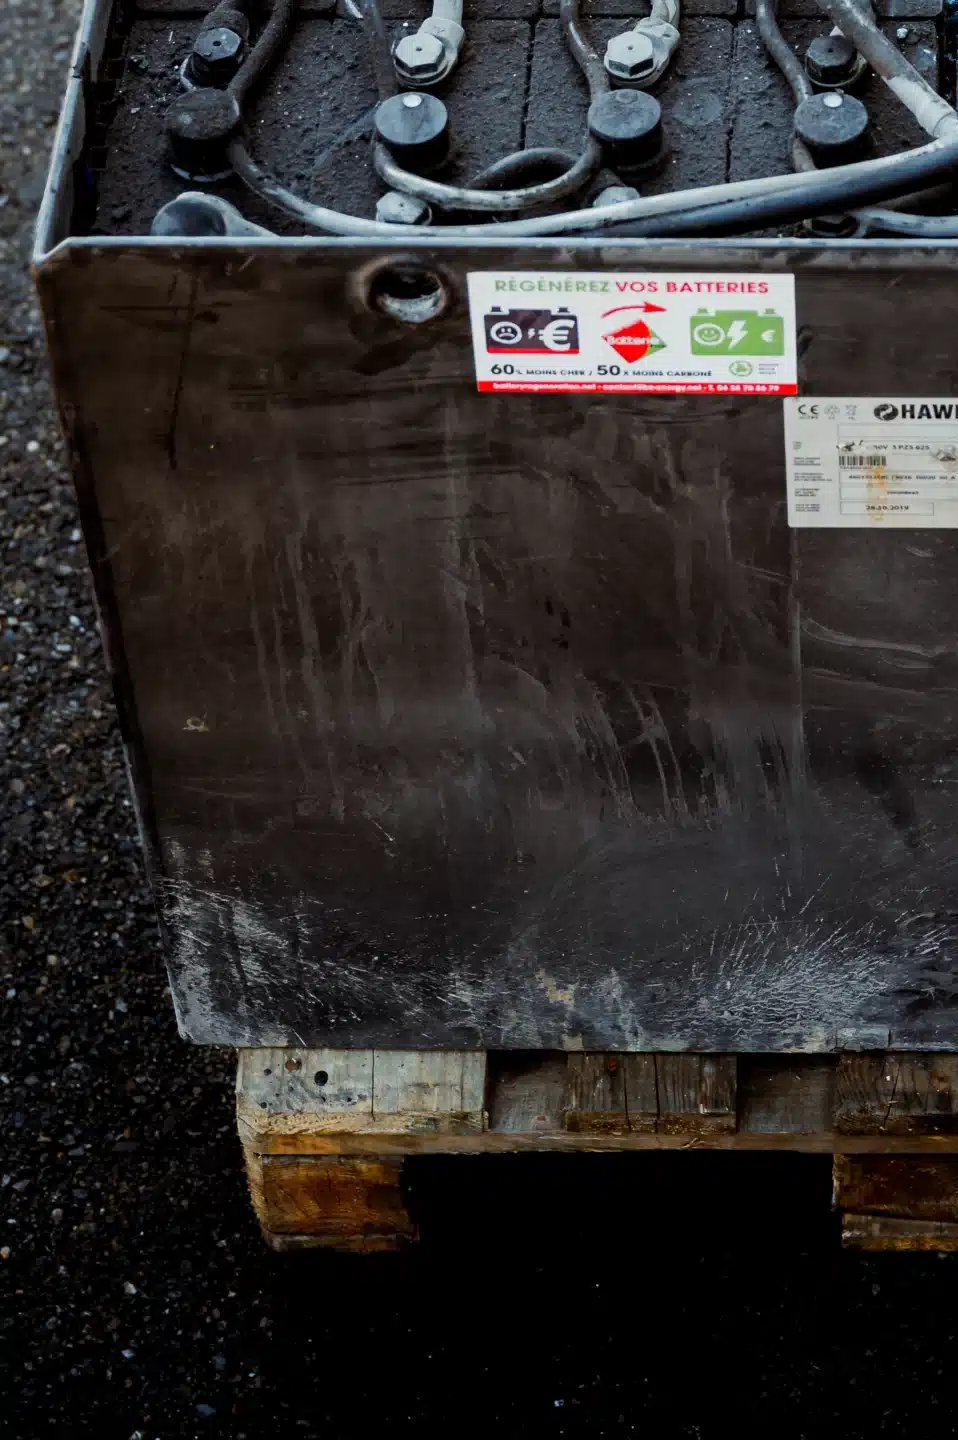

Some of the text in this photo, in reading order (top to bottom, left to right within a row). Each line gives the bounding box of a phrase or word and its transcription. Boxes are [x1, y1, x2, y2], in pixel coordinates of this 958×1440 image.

[494, 276, 770, 295] RÉGÉNÉREZ VOS BATTERIES
[526, 368, 557, 377] MOINS
[560, 369, 585, 377] CHER
[596, 365, 621, 376] 50
[632, 370, 664, 378] MOINS
